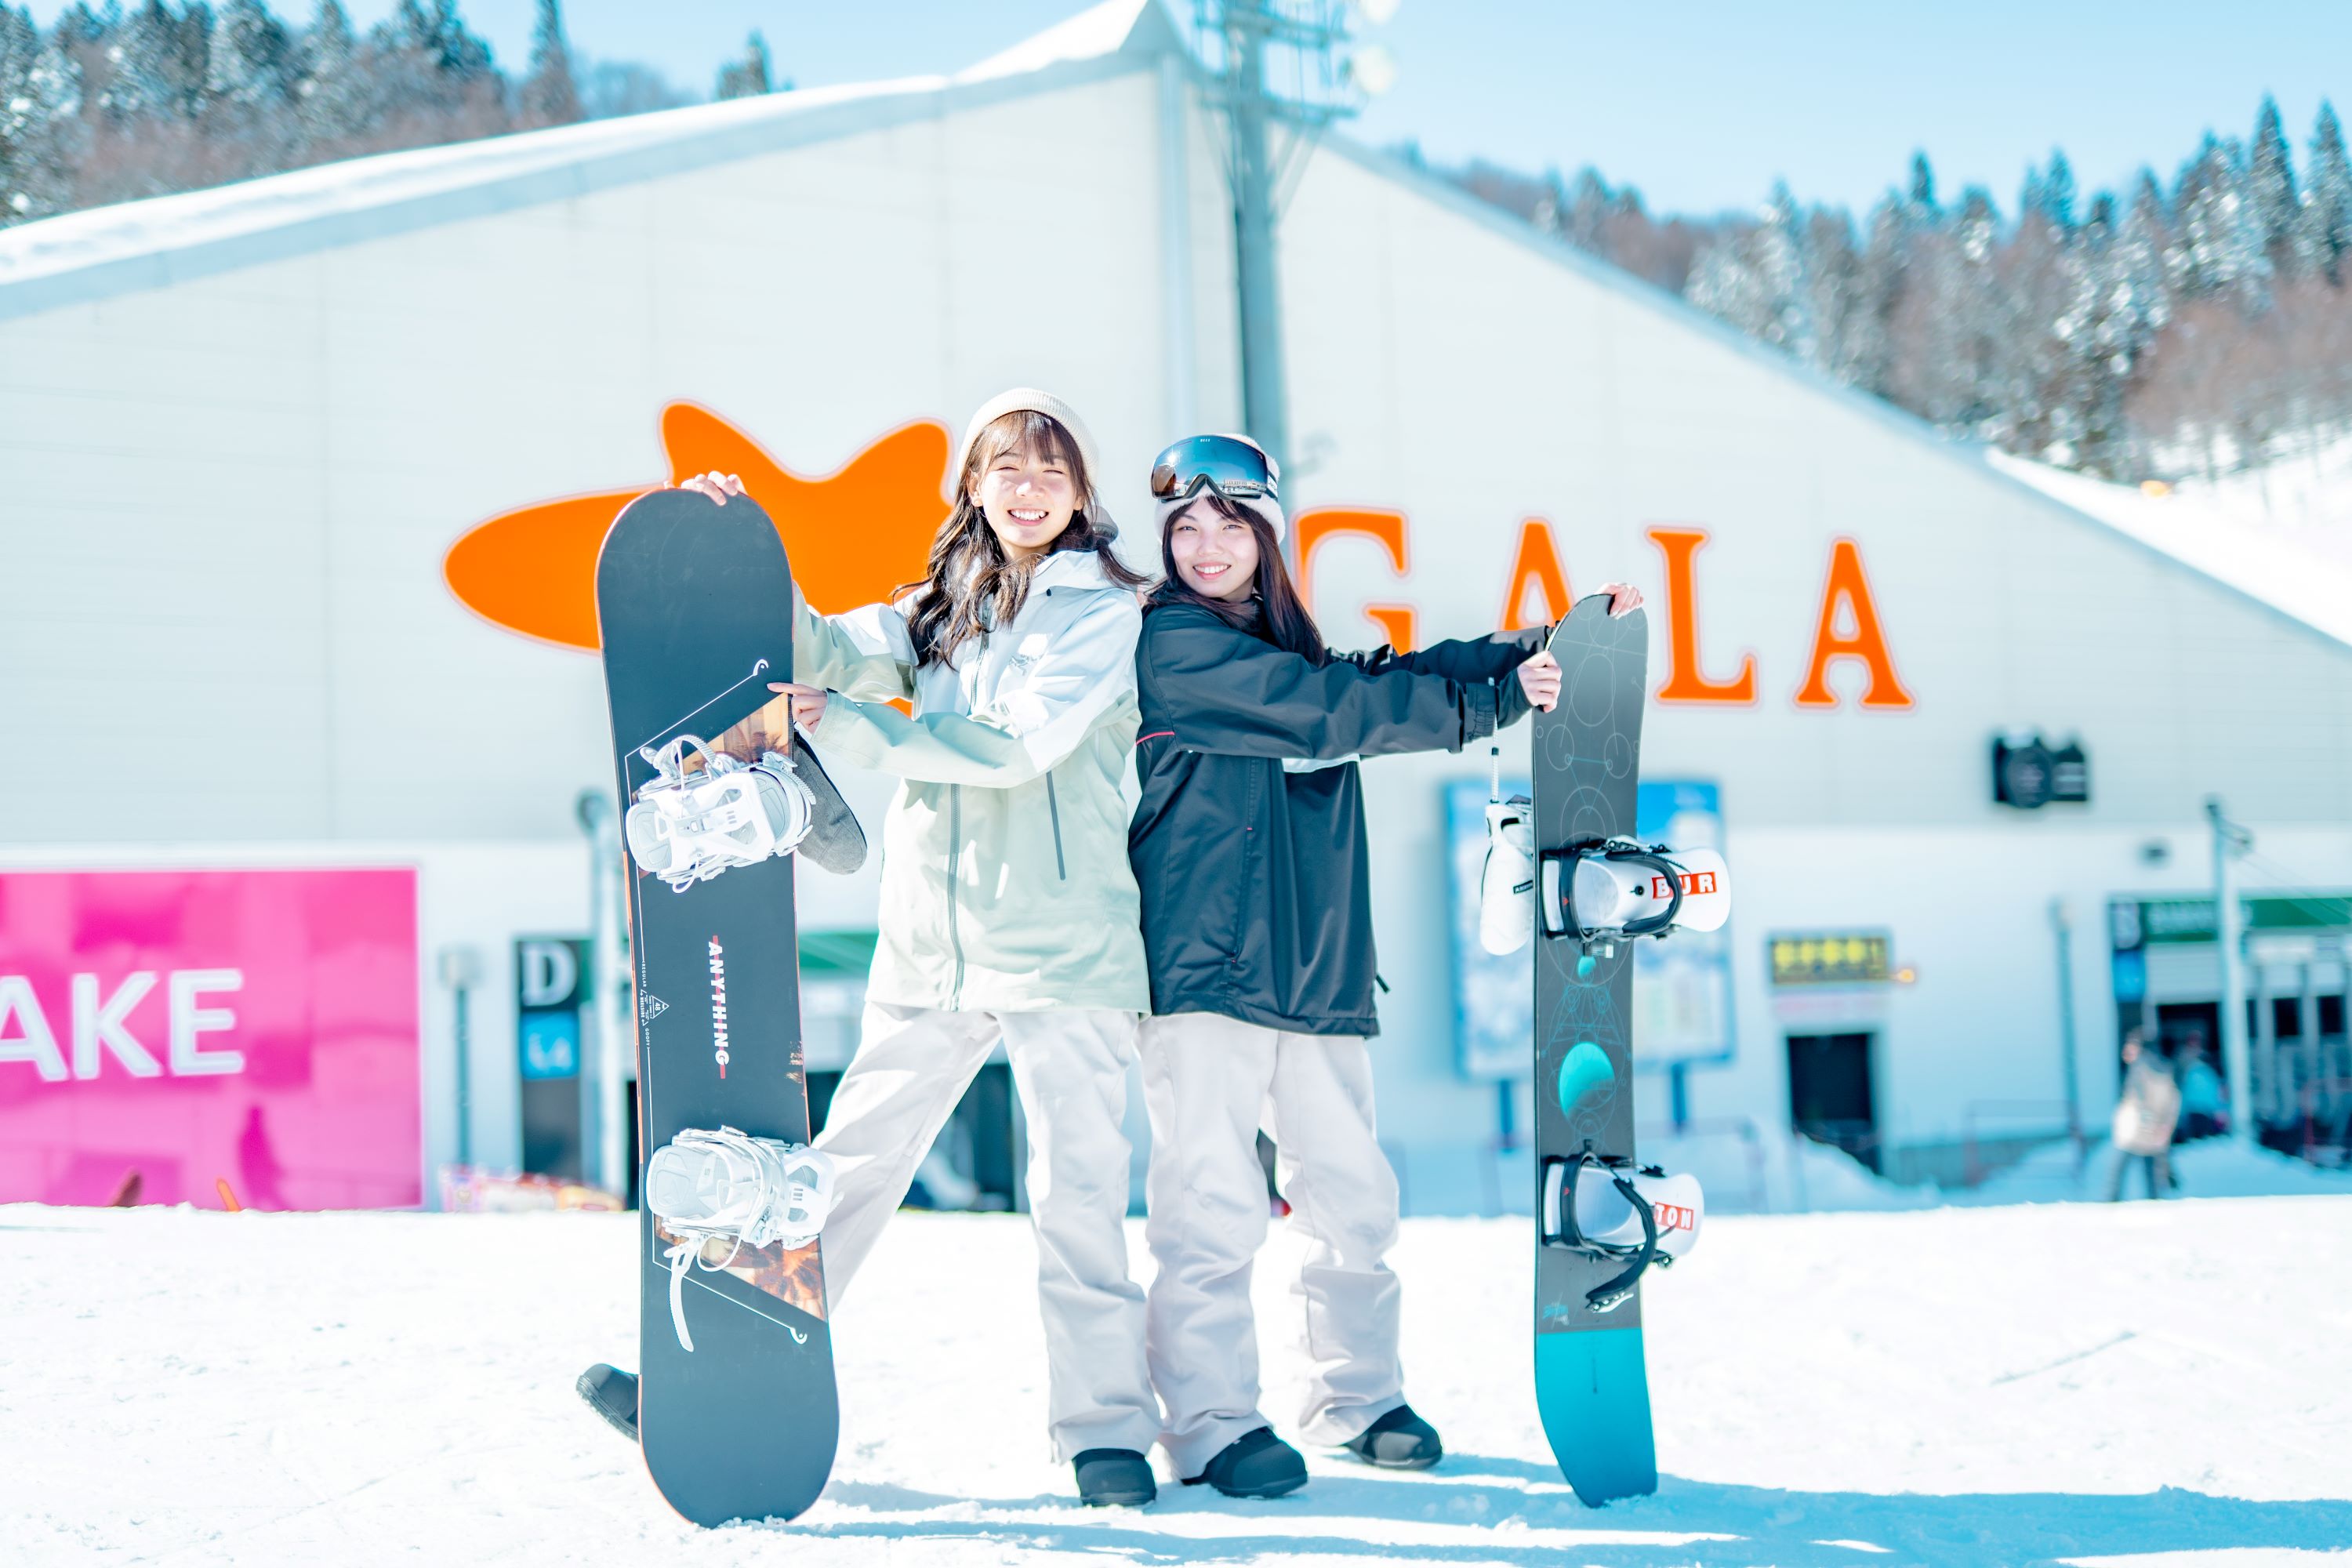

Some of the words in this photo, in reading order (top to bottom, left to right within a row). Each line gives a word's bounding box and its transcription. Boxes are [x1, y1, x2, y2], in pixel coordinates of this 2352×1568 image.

[1294, 508, 1915, 707] GALA
[1656, 874, 1714, 897] BUR
[522, 940, 578, 1007] D
[655, 1002, 661, 1011] 48
[708, 941, 730, 1065] ANYTHING
[0, 968, 245, 1082] AKE
[1656, 1203, 1693, 1229] TON
